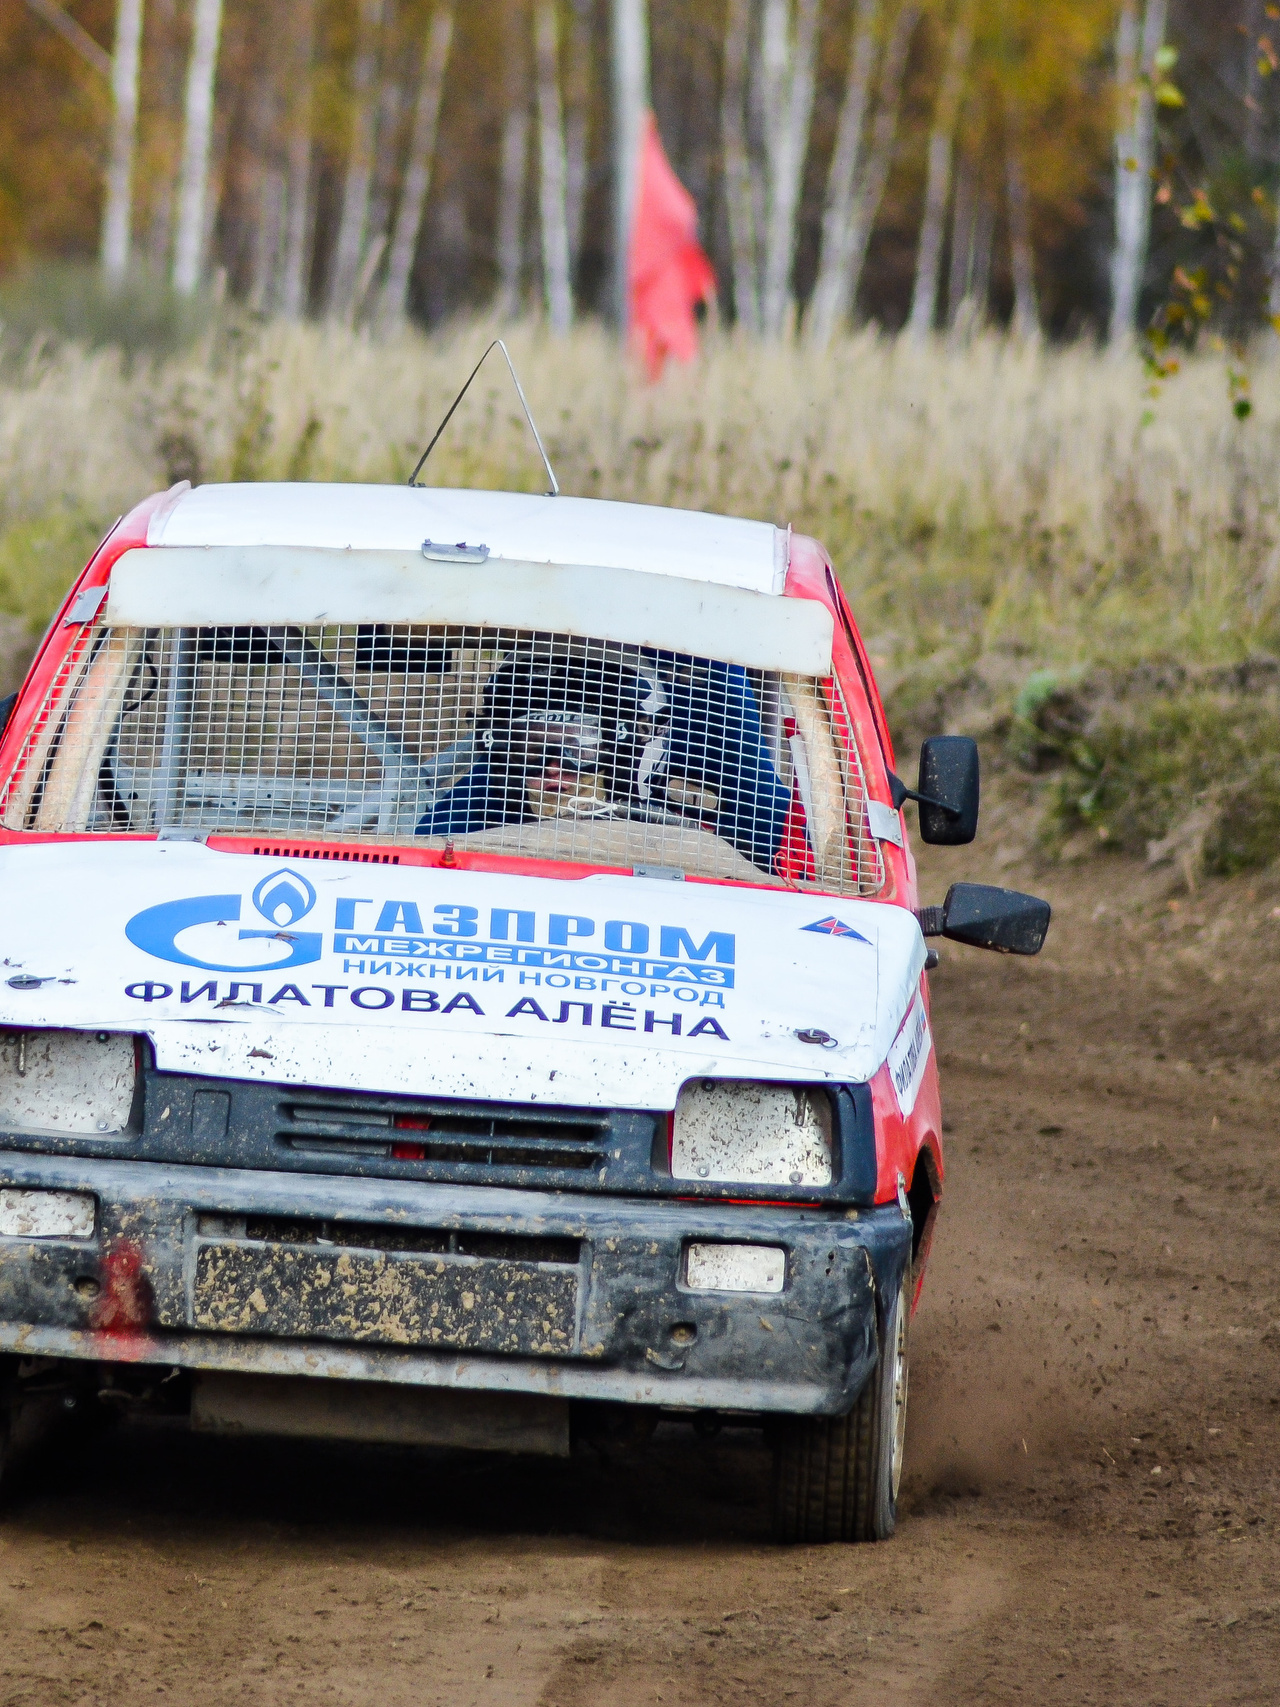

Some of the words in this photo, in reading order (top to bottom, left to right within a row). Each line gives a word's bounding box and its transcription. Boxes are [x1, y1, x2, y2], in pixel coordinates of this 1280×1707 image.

[334, 897, 736, 965] ГАЗПРОМ
[343, 958, 505, 983] НИЖНИЙ
[519, 970, 726, 1009] НОВГОРОД
[345, 936, 726, 985] МЕЖРЕГИОНГАЗ
[124, 980, 486, 1016] ФИЛАТОВА
[504, 996, 731, 1041] АЛЁНА
